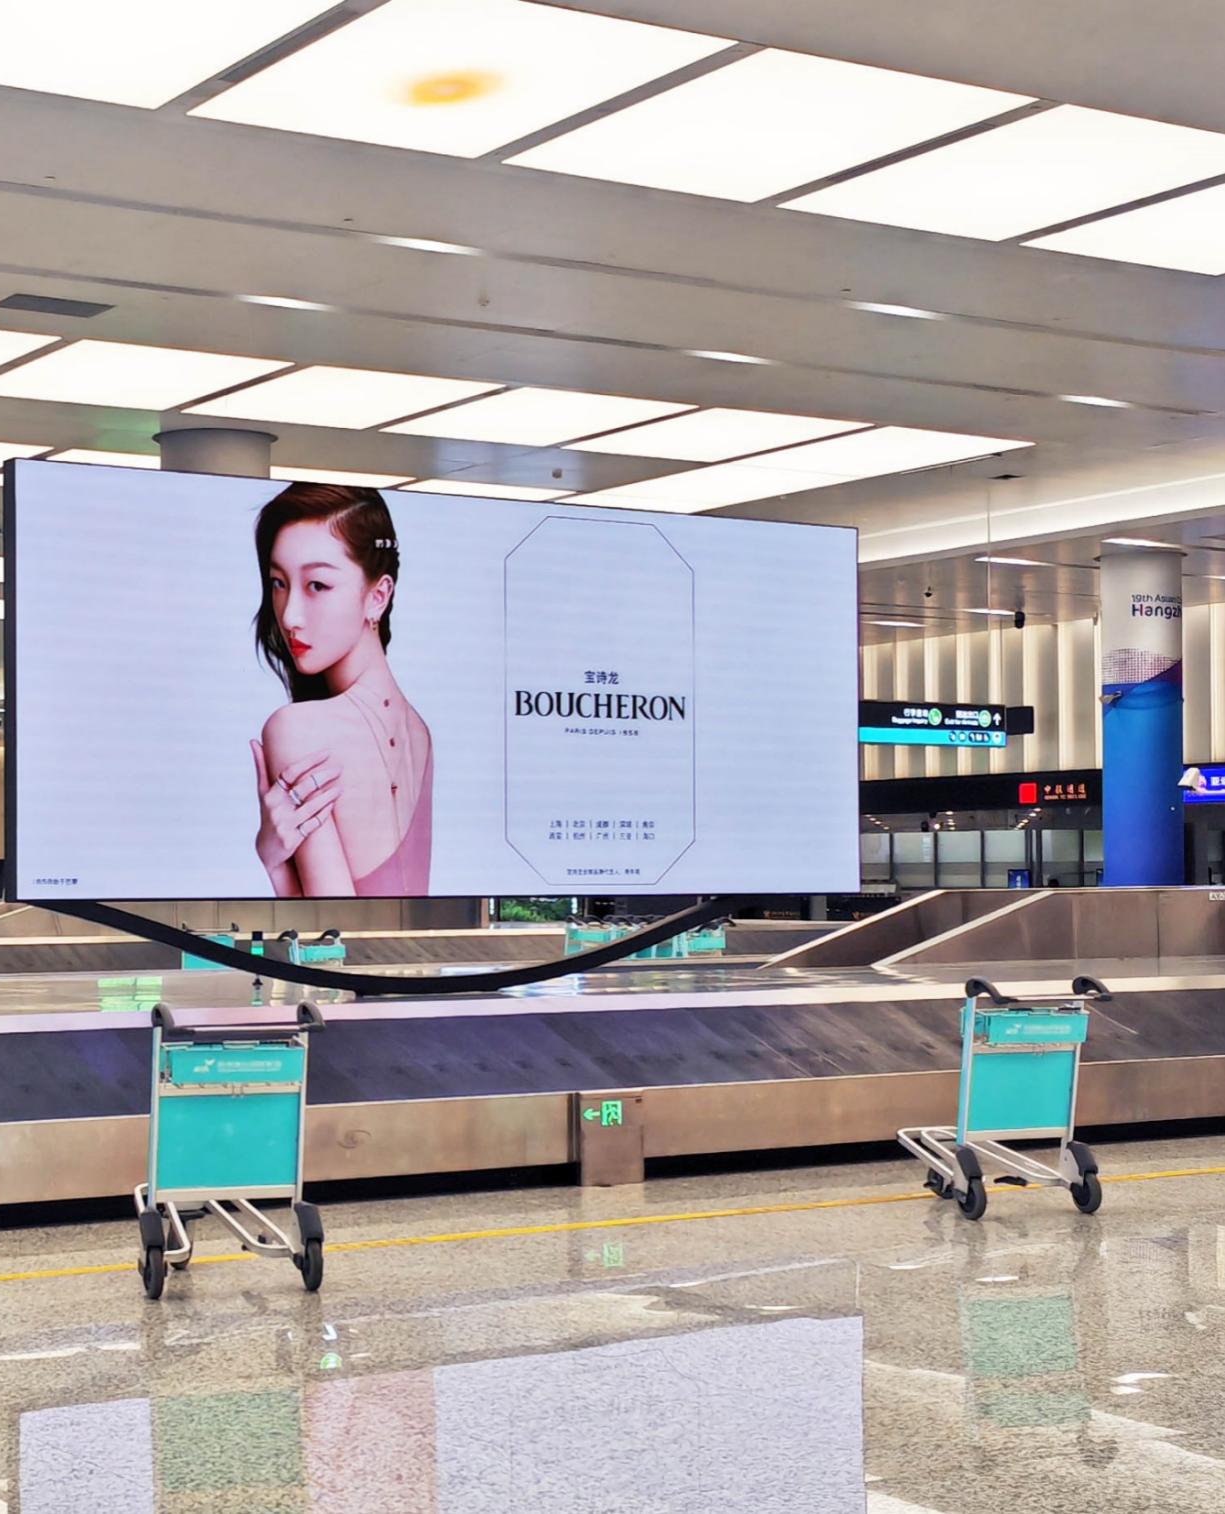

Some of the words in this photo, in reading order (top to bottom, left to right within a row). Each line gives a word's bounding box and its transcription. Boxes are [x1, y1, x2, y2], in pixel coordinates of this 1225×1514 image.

[1131, 594, 1153, 603] 19th
[584, 670, 619, 685] 宝诗龙
[514, 690, 686, 721] BOUCHERON
